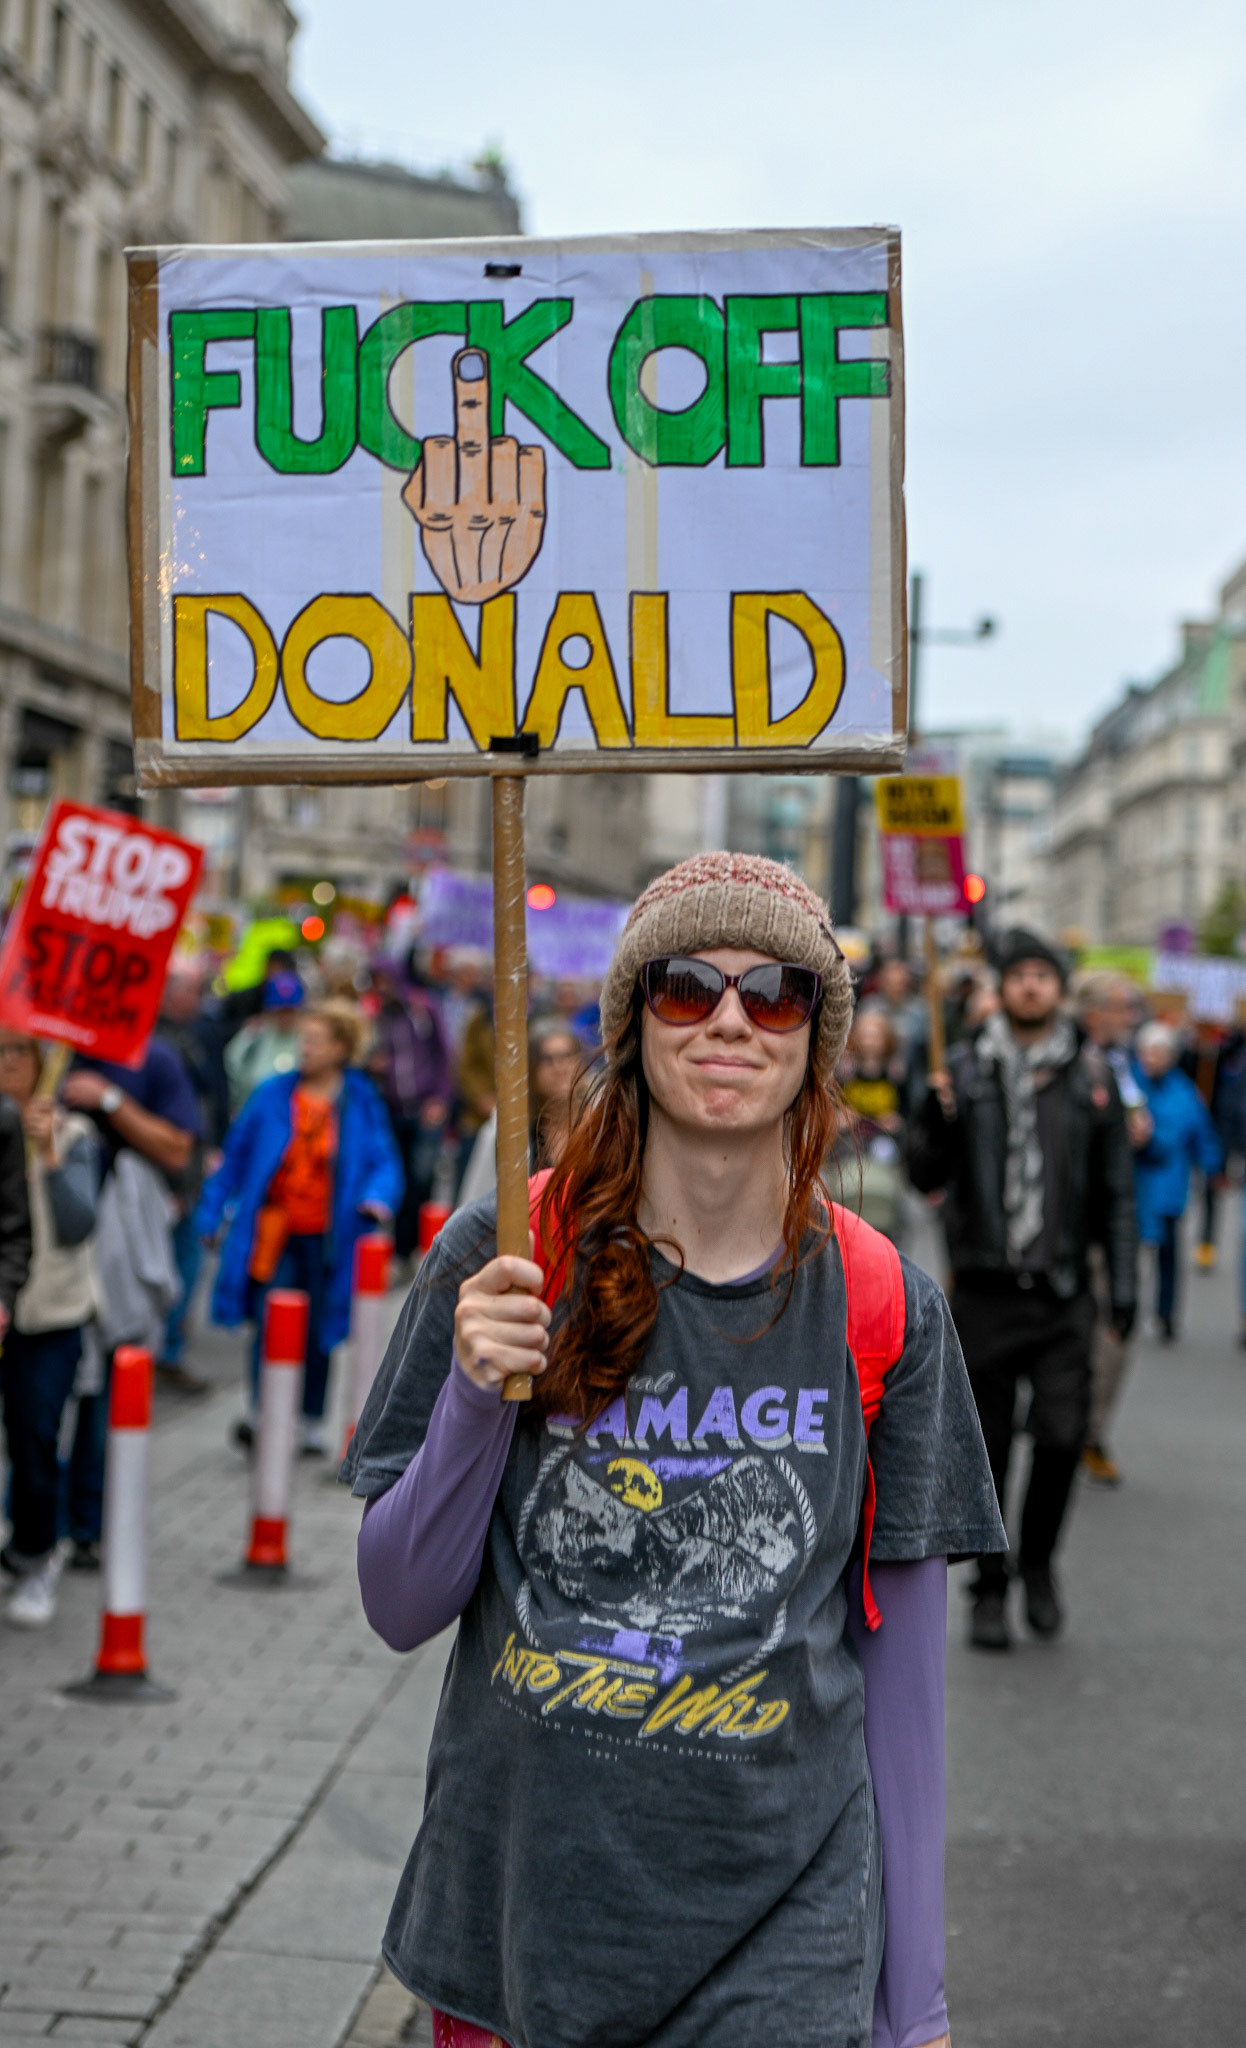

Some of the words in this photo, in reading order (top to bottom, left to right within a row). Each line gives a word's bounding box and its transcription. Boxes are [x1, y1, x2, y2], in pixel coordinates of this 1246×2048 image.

[168, 297, 612, 477] FUCK
[607, 292, 892, 468] OFF
[172, 591, 846, 751] DONALD
[57, 815, 192, 896] STOP
[41, 862, 178, 940] TRUMP
[28, 923, 151, 996] STOP
[546, 1386, 829, 1455] AMAGE
